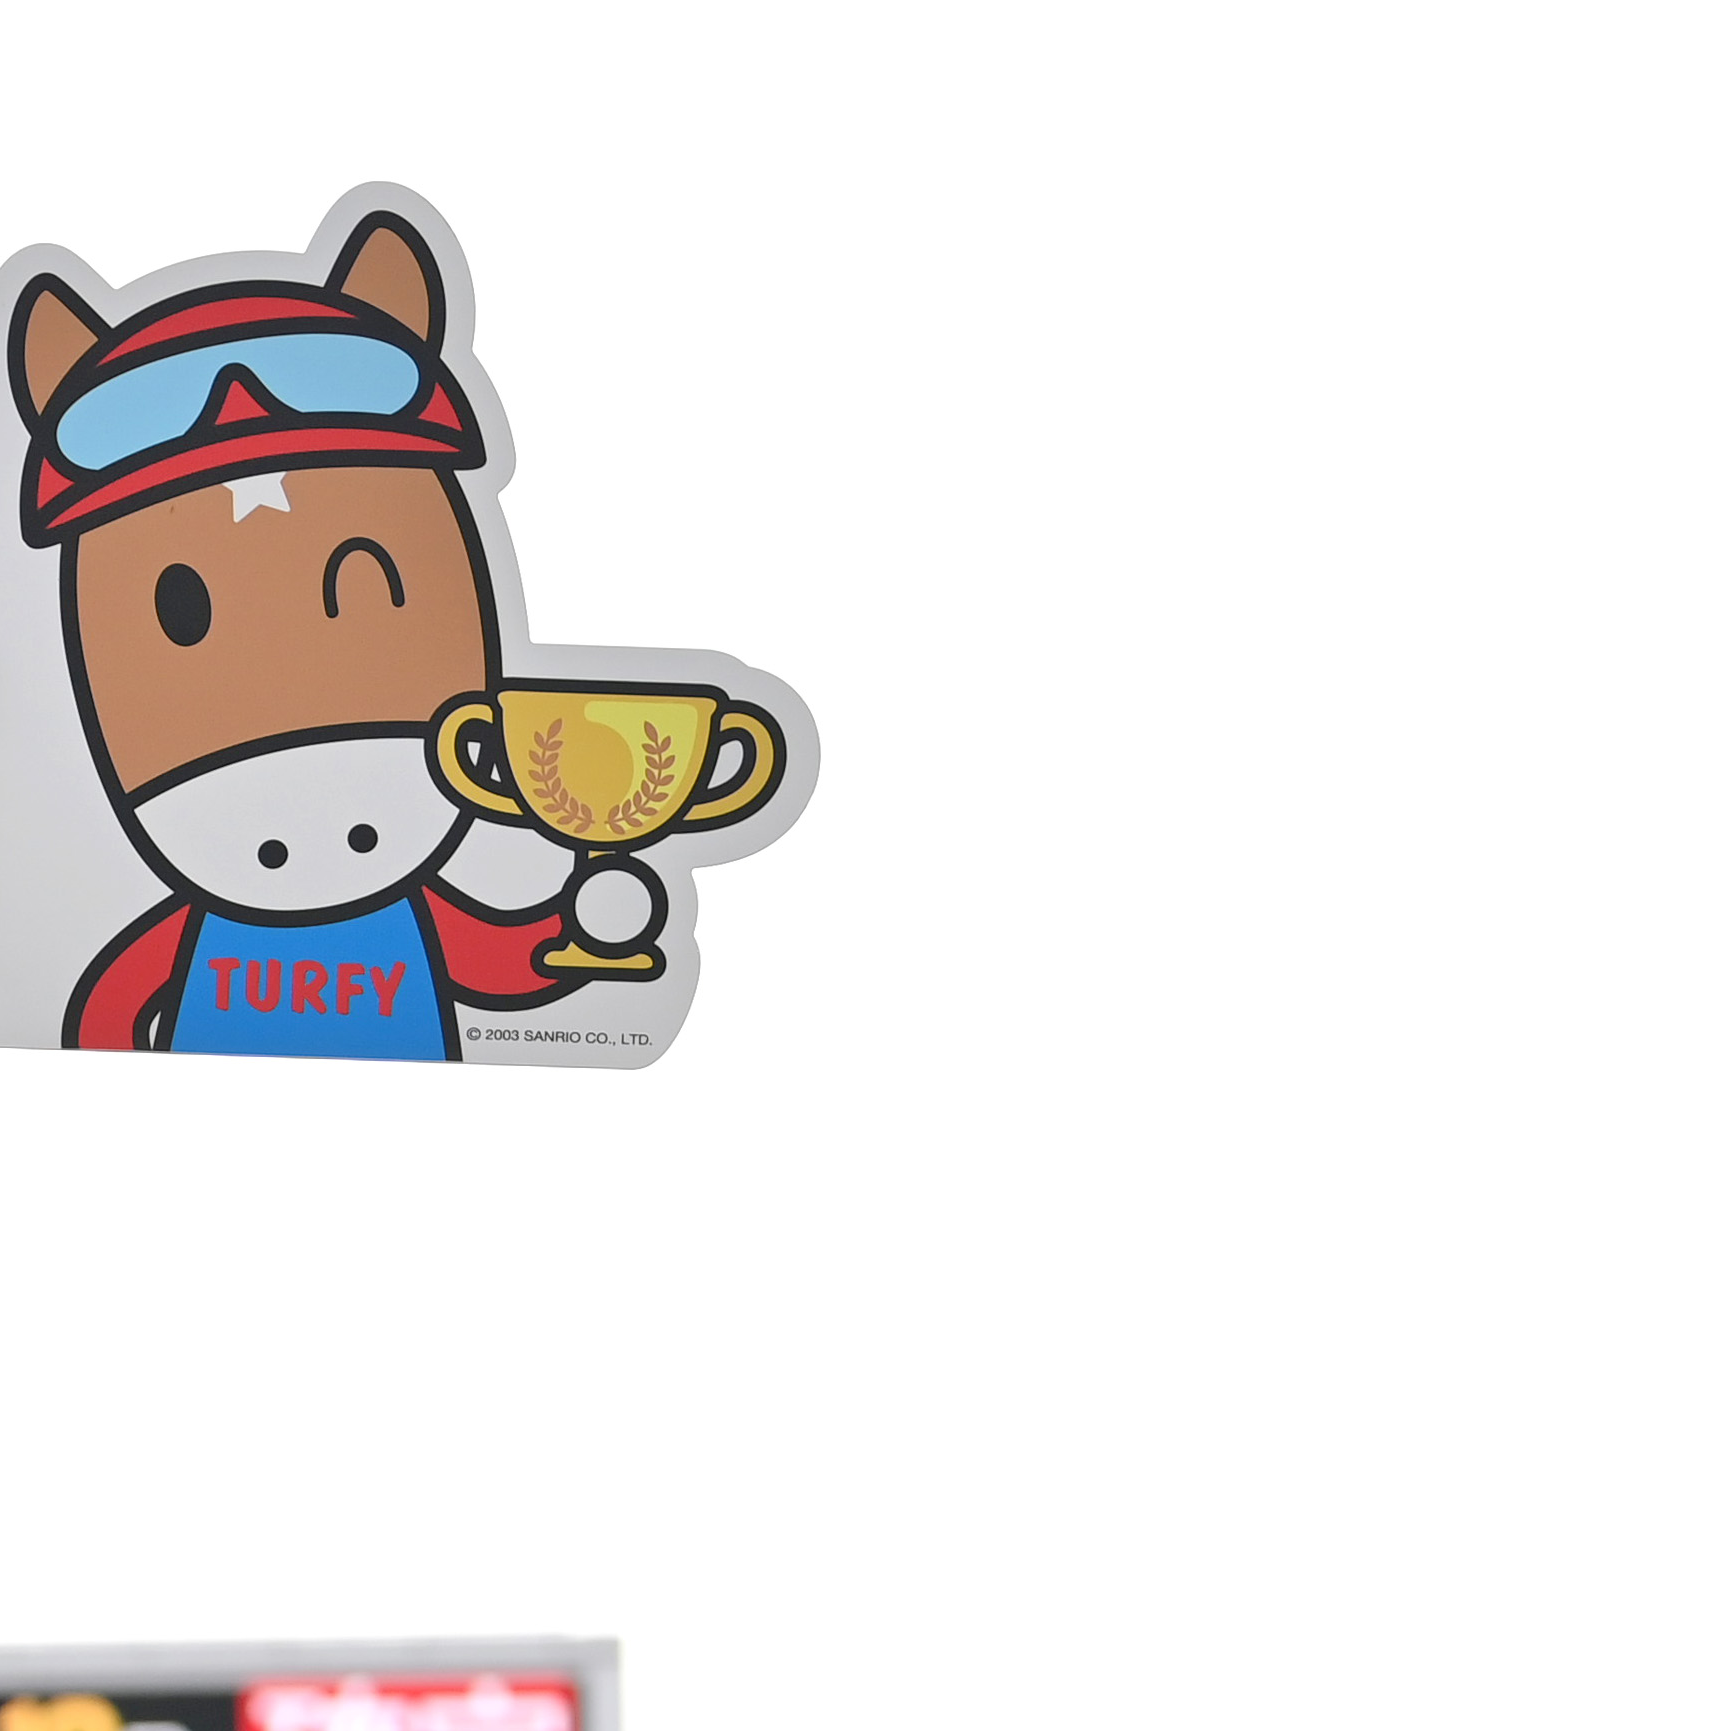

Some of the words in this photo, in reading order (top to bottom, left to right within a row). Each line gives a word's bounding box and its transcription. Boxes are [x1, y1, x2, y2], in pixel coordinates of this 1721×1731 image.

[207, 956, 407, 1018] TURFY
[484, 1028, 520, 1042] 2003
[523, 1029, 581, 1044] SANRIO
[585, 1031, 617, 1047] CO.,
[621, 1033, 653, 1047] LTD.
